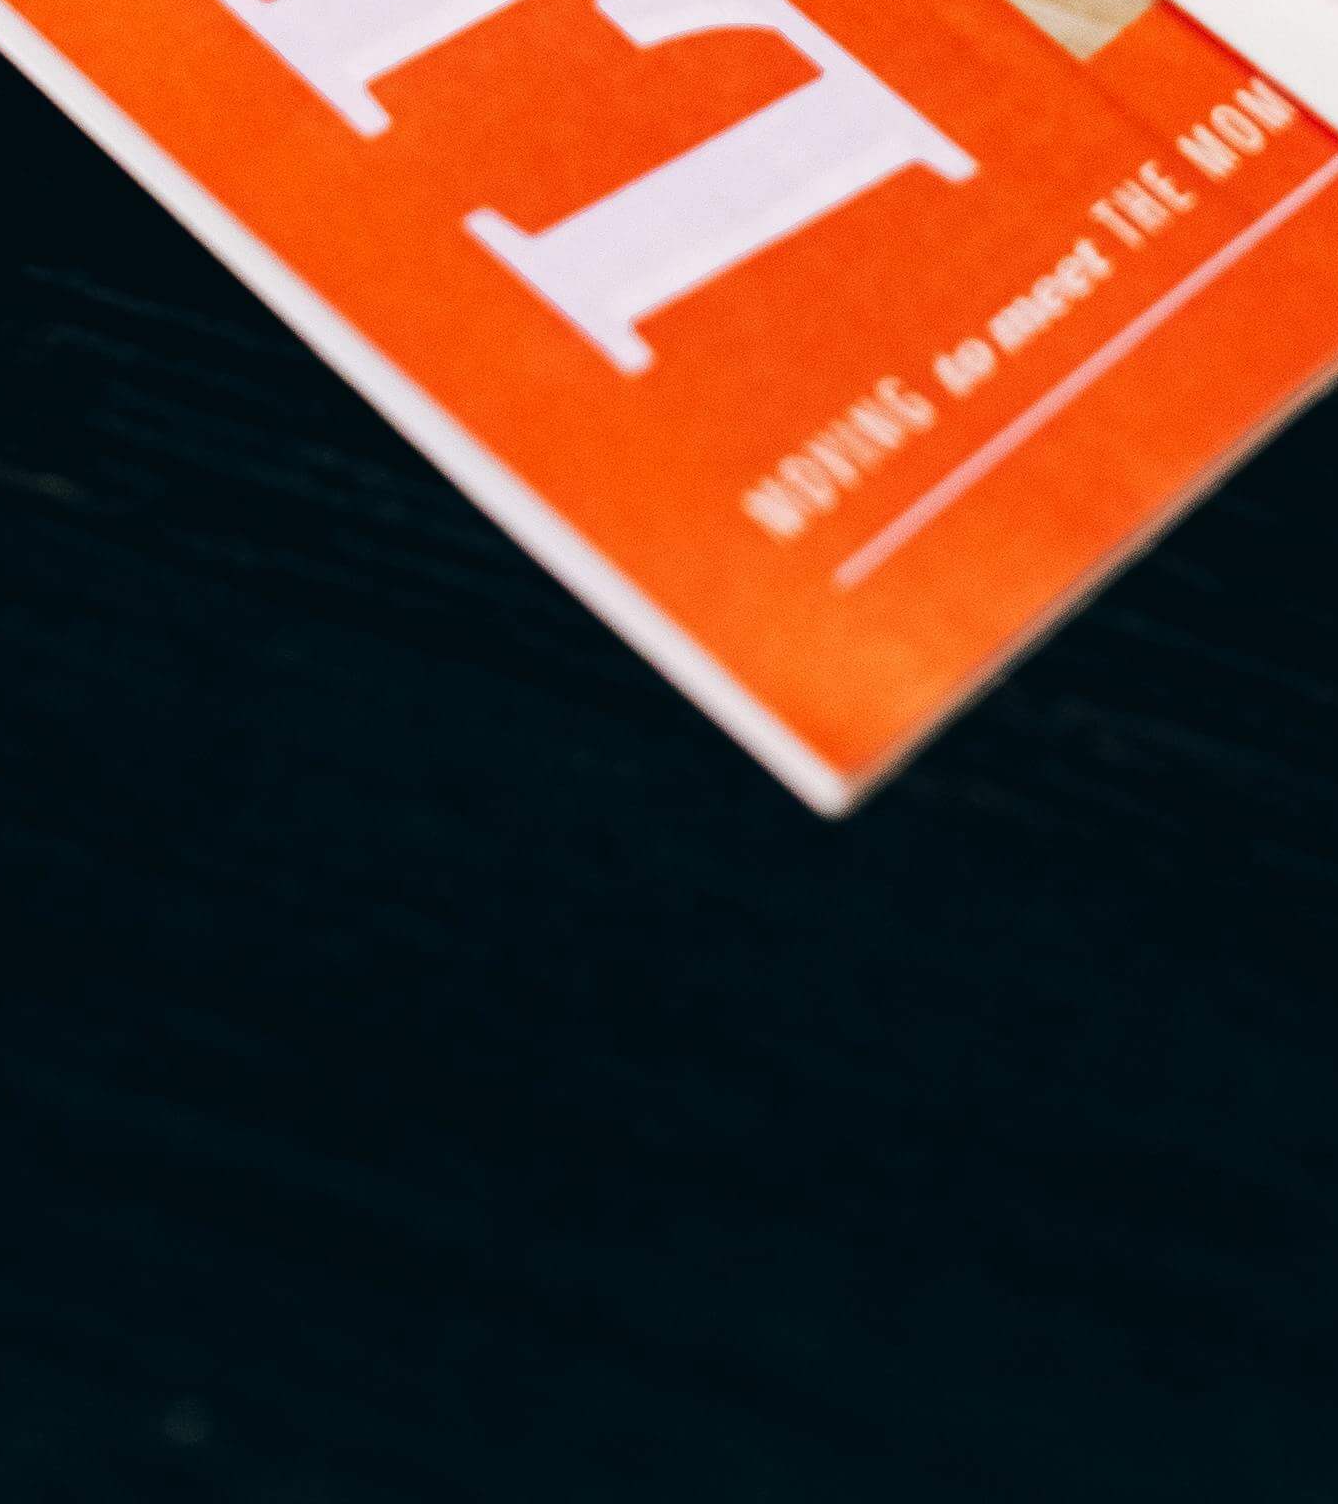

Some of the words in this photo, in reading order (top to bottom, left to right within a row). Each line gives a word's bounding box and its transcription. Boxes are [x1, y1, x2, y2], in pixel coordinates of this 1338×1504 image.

[735, 366, 940, 547] MOVING
[925, 325, 1001, 399] to
[980, 233, 1115, 354] meet
[1085, 153, 1194, 257] THE
